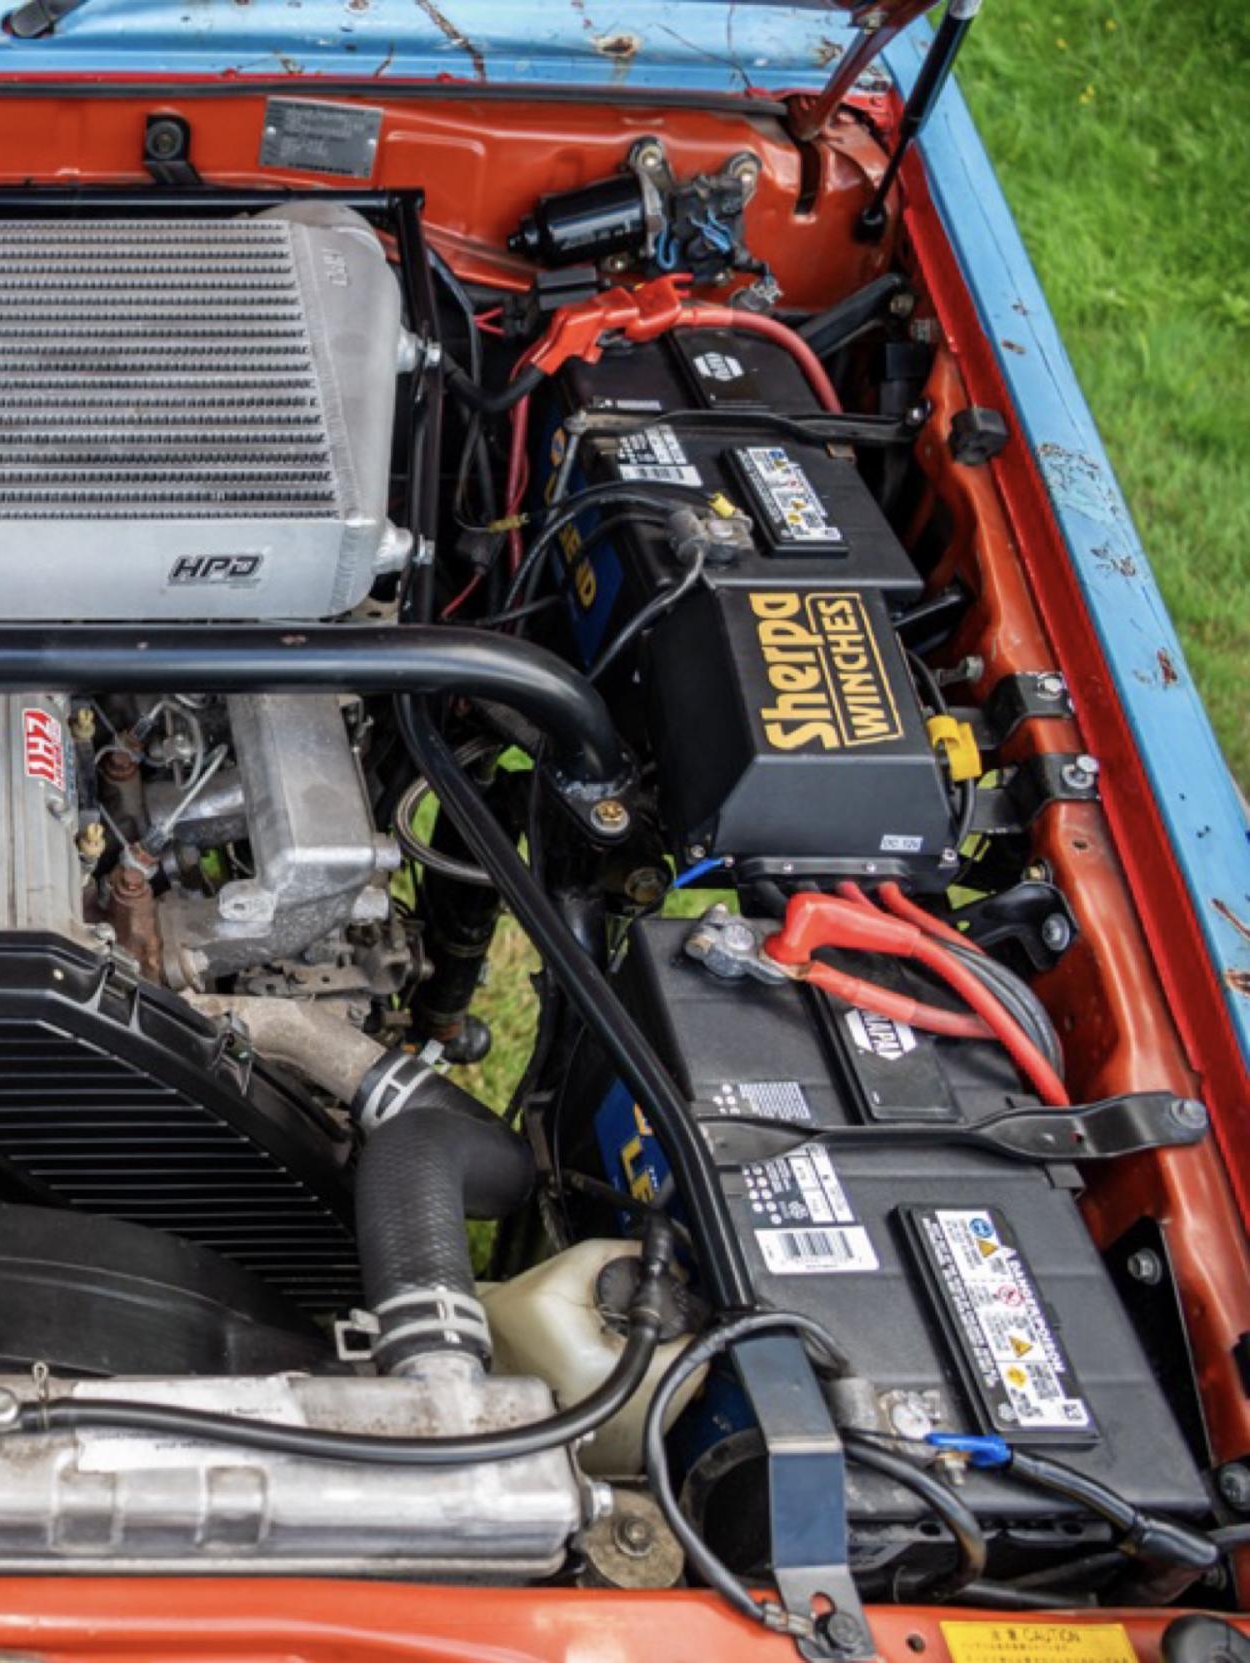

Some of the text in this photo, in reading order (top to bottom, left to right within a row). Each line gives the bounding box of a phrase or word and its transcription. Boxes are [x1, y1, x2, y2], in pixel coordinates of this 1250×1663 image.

[171, 555, 261, 579] HPD
[749, 593, 841, 750] Sherpa
[817, 600, 891, 738] WINCHES
